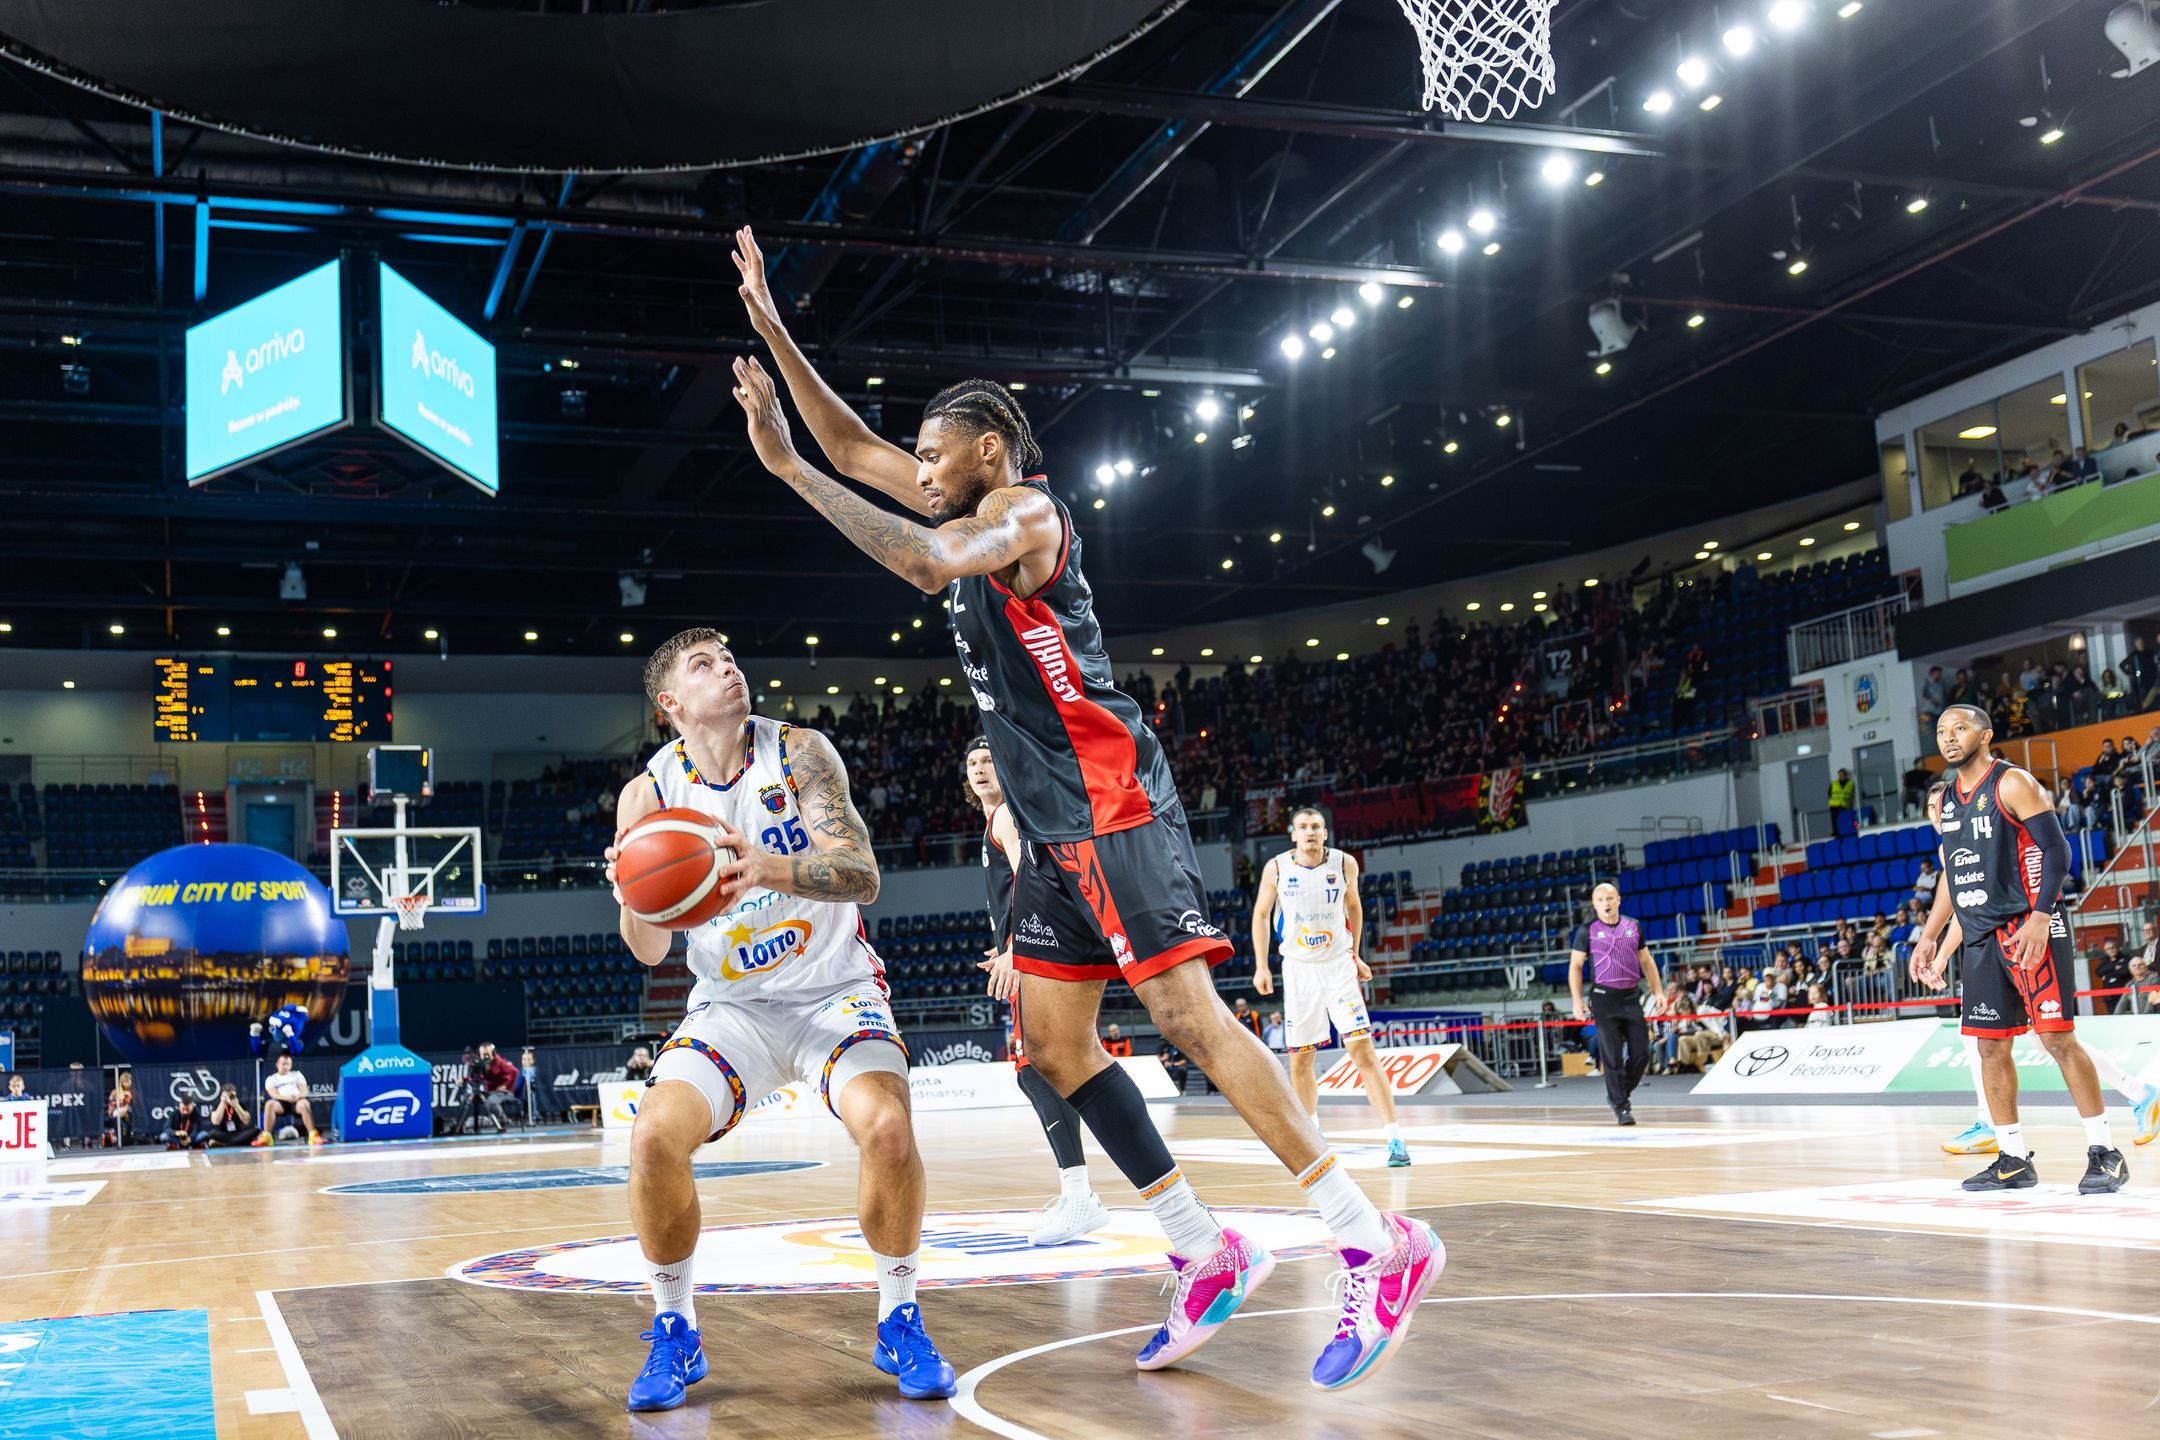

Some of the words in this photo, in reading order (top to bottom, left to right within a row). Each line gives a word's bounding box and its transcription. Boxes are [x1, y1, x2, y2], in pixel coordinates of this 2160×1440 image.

[245, 328, 305, 374] arriva
[431, 350, 475, 398] arriva
[1547, 649, 1573, 672] T2
[761, 815, 809, 855] 35
[1971, 815, 1993, 840] 14
[1955, 853, 1980, 867] Enea
[182, 882, 229, 903] CITY
[231, 881, 257, 902] OF
[260, 881, 308, 901] SPORT
[1326, 889, 1339, 903] 17
[739, 930, 796, 969] LOTTO
[1016, 934, 1056, 946] BYDGOSZCZ
[1305, 935, 1327, 946] LOTTO
[1505, 965, 1535, 991] VIP
[859, 1020, 889, 1029] errea
[971, 1004, 994, 1026] S1
[375, 1056, 414, 1069] arriva
[1809, 1045, 1865, 1060] Toyota
[1790, 1064, 1883, 1078] Bednarscy
[356, 1105, 408, 1126] PGE
